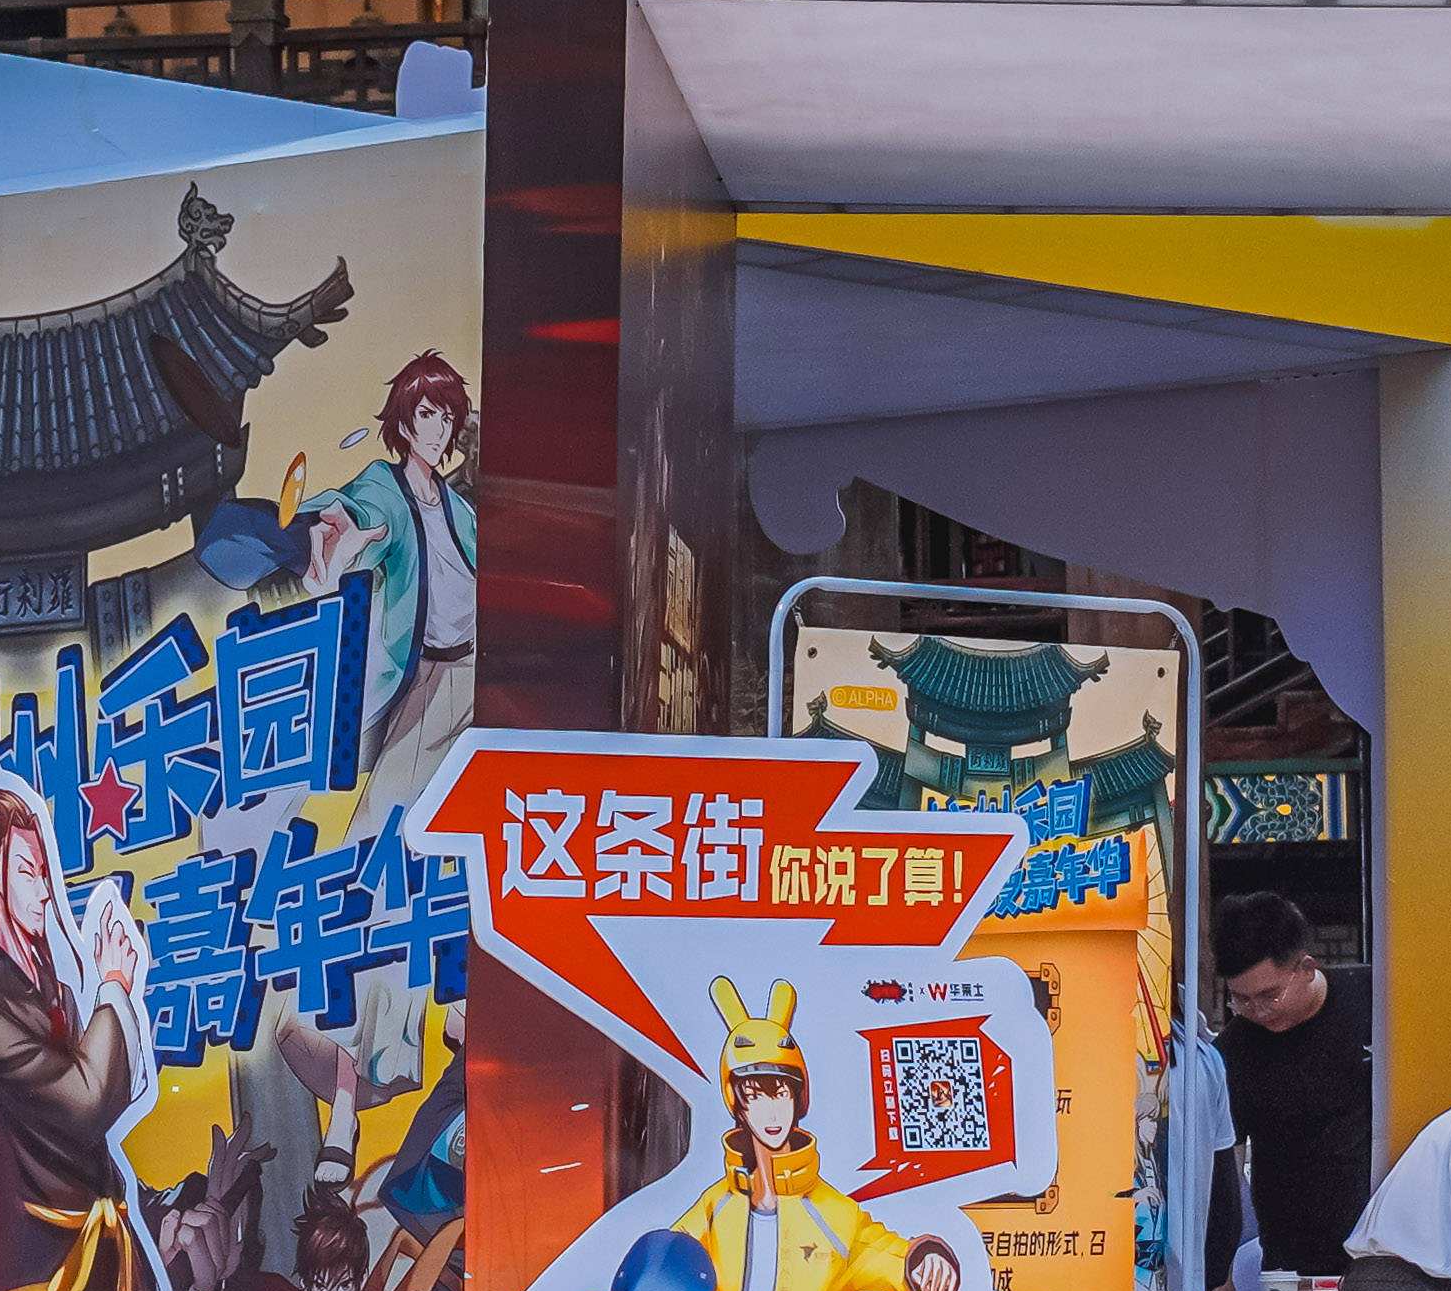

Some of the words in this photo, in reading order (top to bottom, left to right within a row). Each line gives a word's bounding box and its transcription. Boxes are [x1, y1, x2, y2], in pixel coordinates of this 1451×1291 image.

[501, 787, 765, 902] 这条街
[769, 843, 963, 907] 你说了算！
